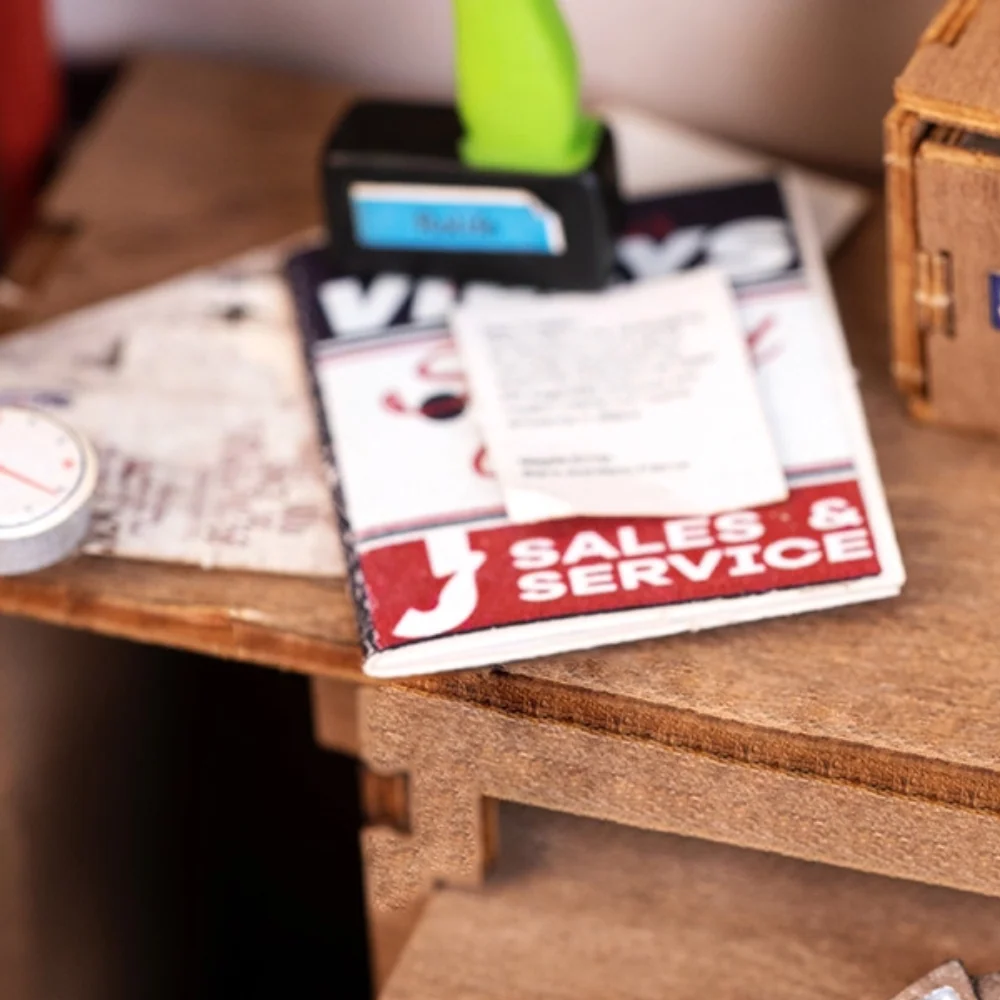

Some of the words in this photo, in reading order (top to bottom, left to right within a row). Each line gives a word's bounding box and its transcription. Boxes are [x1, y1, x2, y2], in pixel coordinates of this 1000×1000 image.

[509, 510, 766, 571] SALES
[808, 496, 864, 532] &
[517, 530, 876, 602] SERVICE
